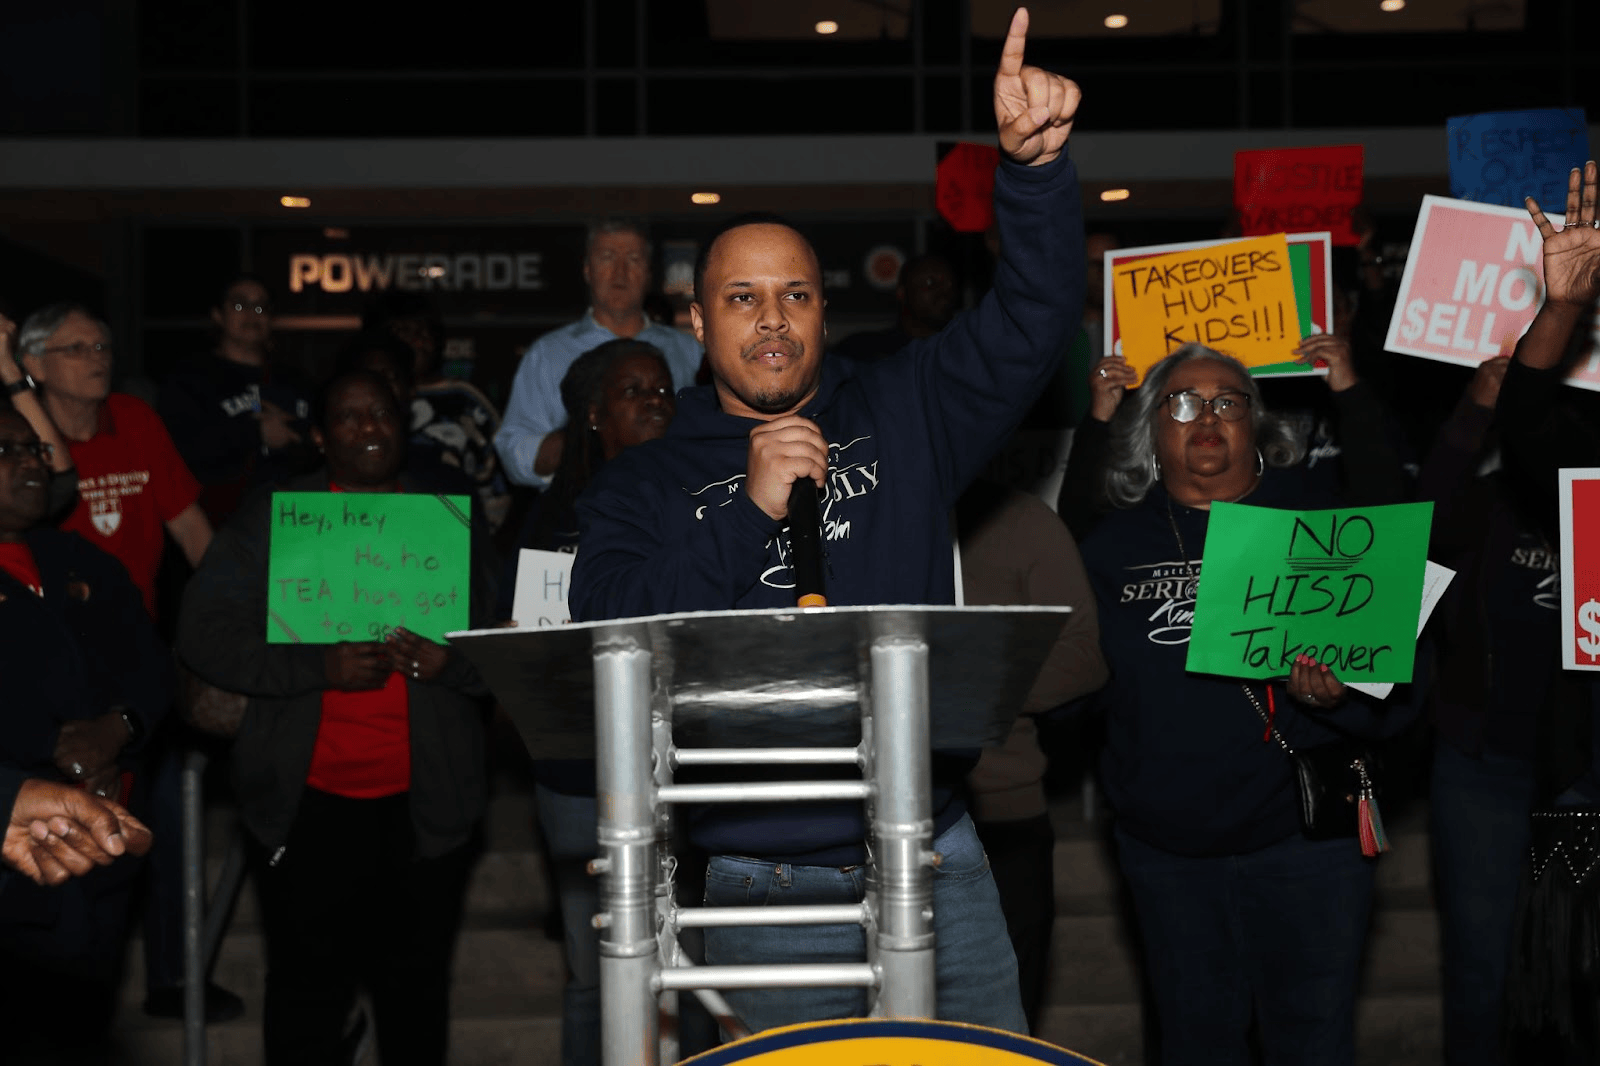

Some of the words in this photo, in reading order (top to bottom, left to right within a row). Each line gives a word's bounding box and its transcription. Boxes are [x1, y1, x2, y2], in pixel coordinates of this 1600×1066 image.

[288, 253, 543, 294] POWERADE
[1118, 250, 1282, 298] TAKEOVERS
[1162, 276, 1257, 318] HURT
[1164, 301, 1285, 353] KIDS!!!
[279, 501, 333, 536] Hey,
[342, 500, 387, 534] hey
[1289, 514, 1375, 559] NO
[401, 543, 440, 571] ho
[276, 577, 333, 603] TEA
[353, 578, 401, 606] has
[415, 585, 460, 616] got
[1242, 573, 1375, 618] HISD
[321, 610, 353, 636] to
